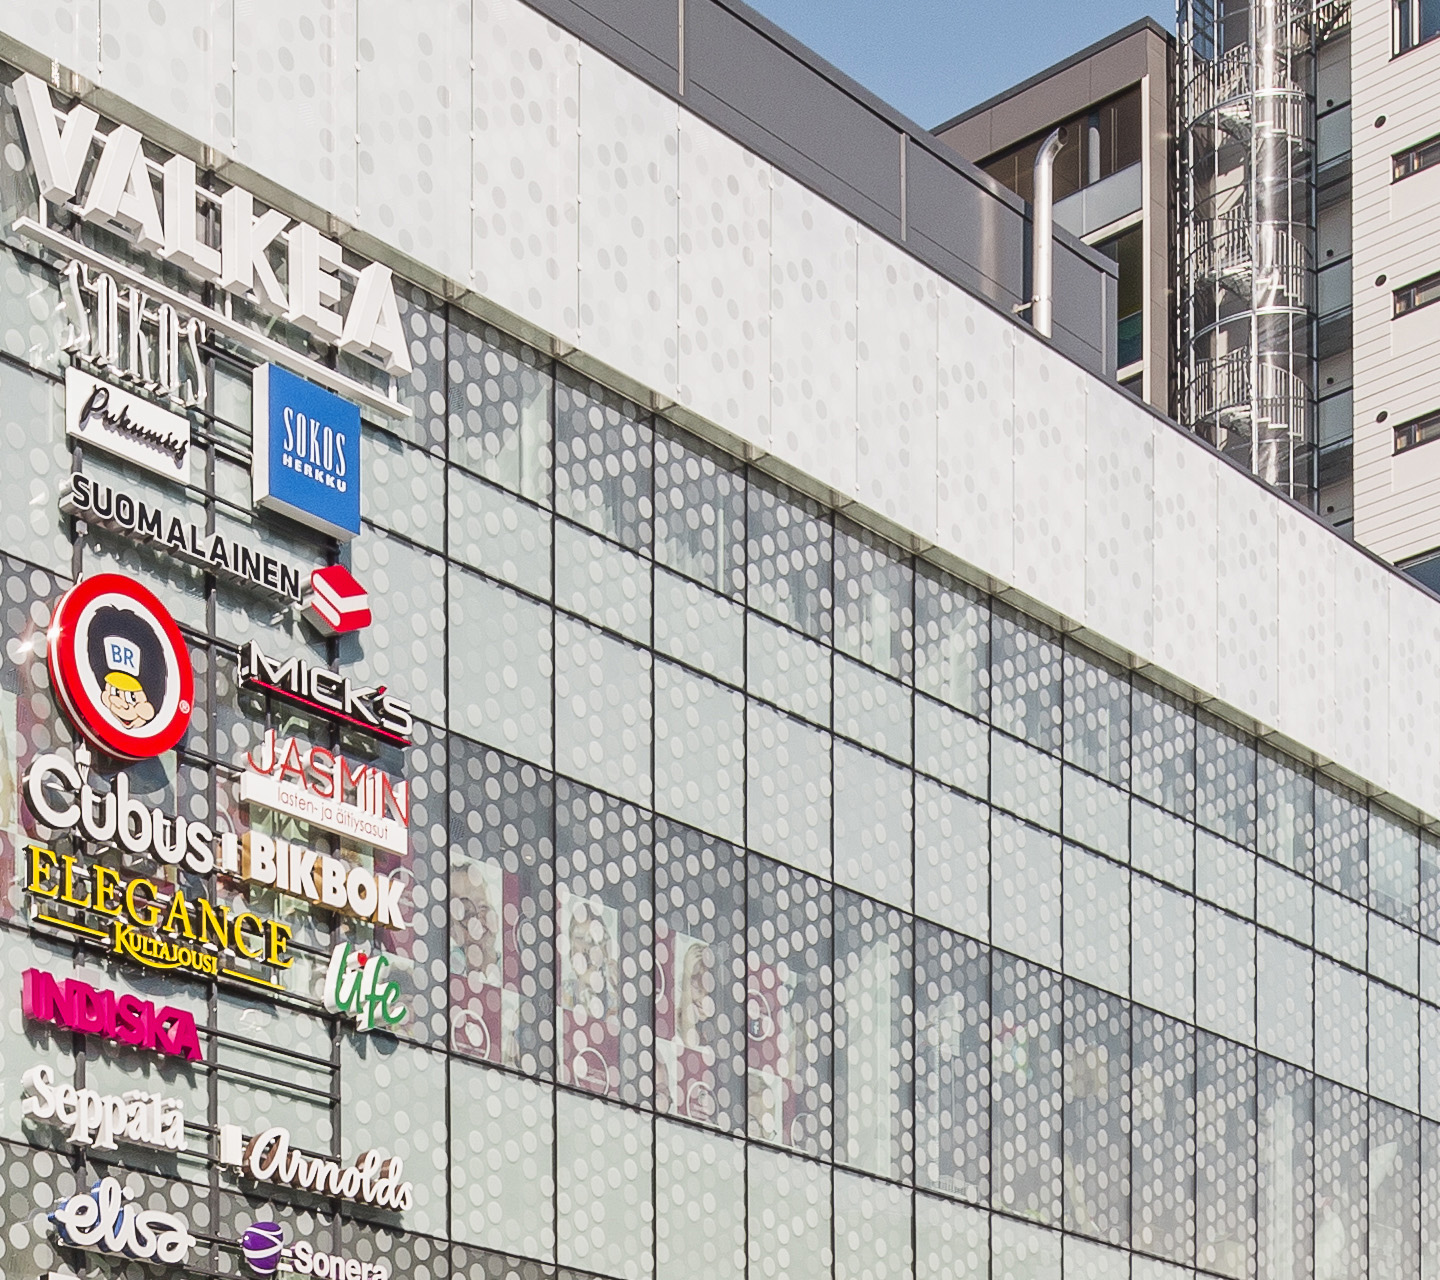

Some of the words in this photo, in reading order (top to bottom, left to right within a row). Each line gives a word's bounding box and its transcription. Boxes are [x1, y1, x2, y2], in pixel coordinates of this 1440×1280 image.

[13, 71, 414, 378] VALKEA
[60, 258, 208, 408] SOKOS
[282, 453, 347, 493] HERKKU
[283, 406, 346, 476] SOKOS
[70, 471, 303, 605] SUOMALAINEN
[110, 643, 134, 668] BR
[249, 638, 413, 736] MICK'S
[23, 752, 215, 873] Cubus
[277, 786, 318, 816] lasten-
[321, 803, 332, 821] ja
[336, 808, 388, 841] äitiysasut
[26, 844, 294, 969] ELEGANCE
[21, 967, 203, 1061] INDISKA
[21, 1064, 188, 1151] Seppälä
[245, 1126, 415, 1211] Arnolds
[50, 1177, 196, 1265] elisa
